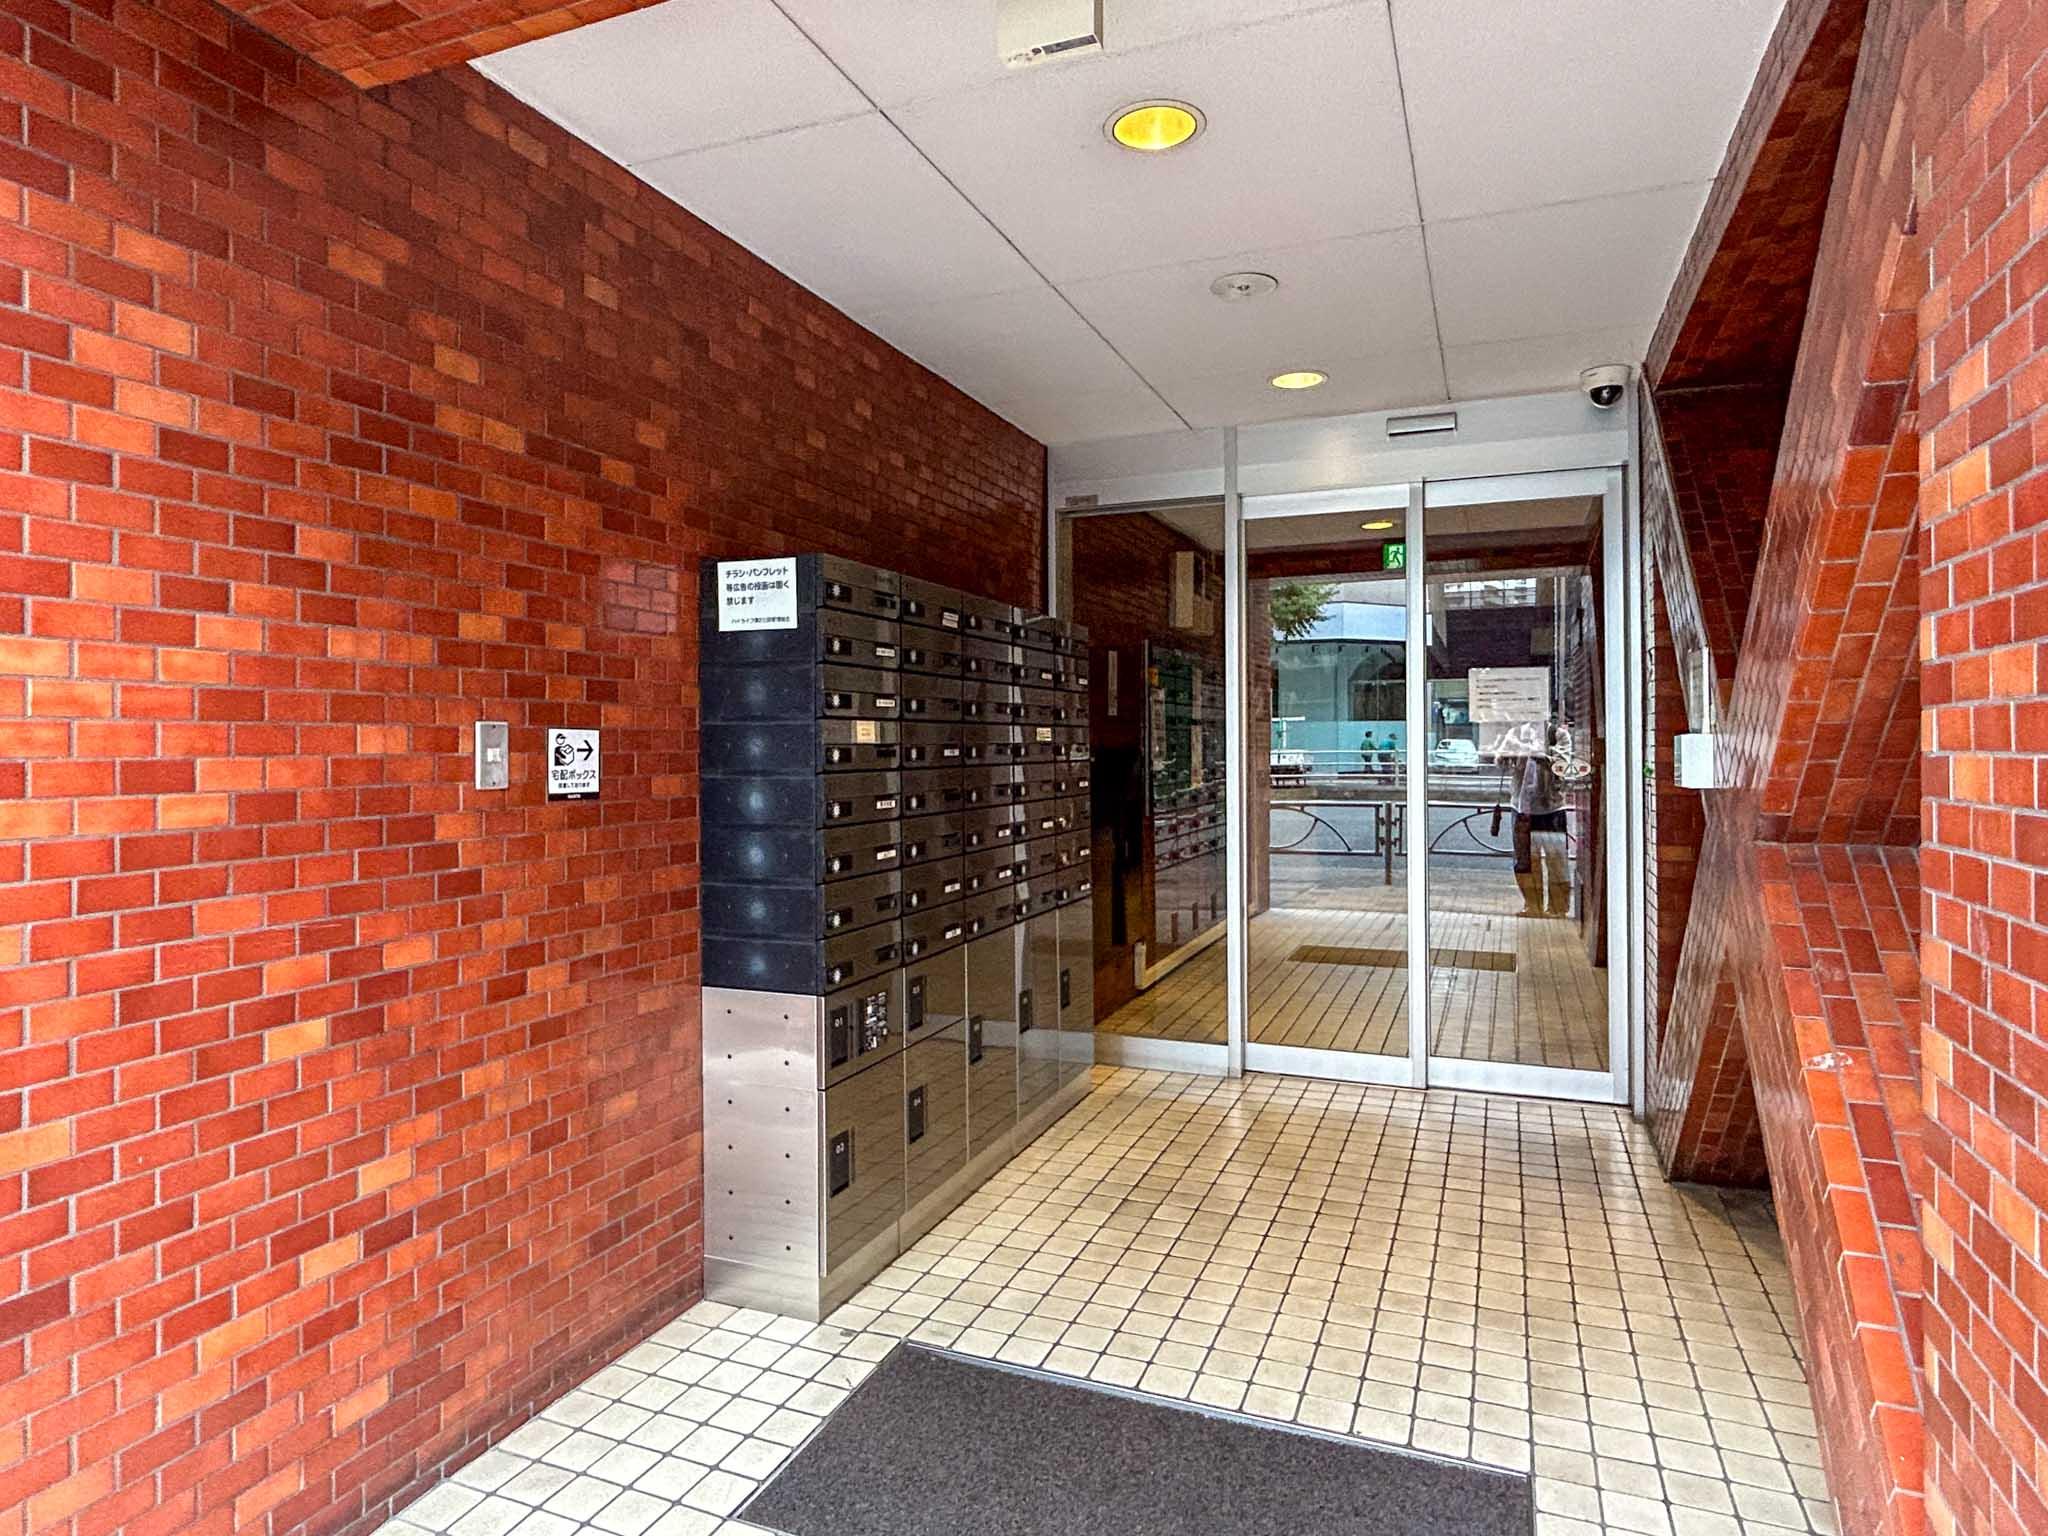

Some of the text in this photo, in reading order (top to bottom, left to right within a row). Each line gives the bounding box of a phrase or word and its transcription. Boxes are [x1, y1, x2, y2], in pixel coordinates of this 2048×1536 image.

[726, 596, 754, 606] 禁じます
[552, 769, 596, 781] 宅配ボックス
